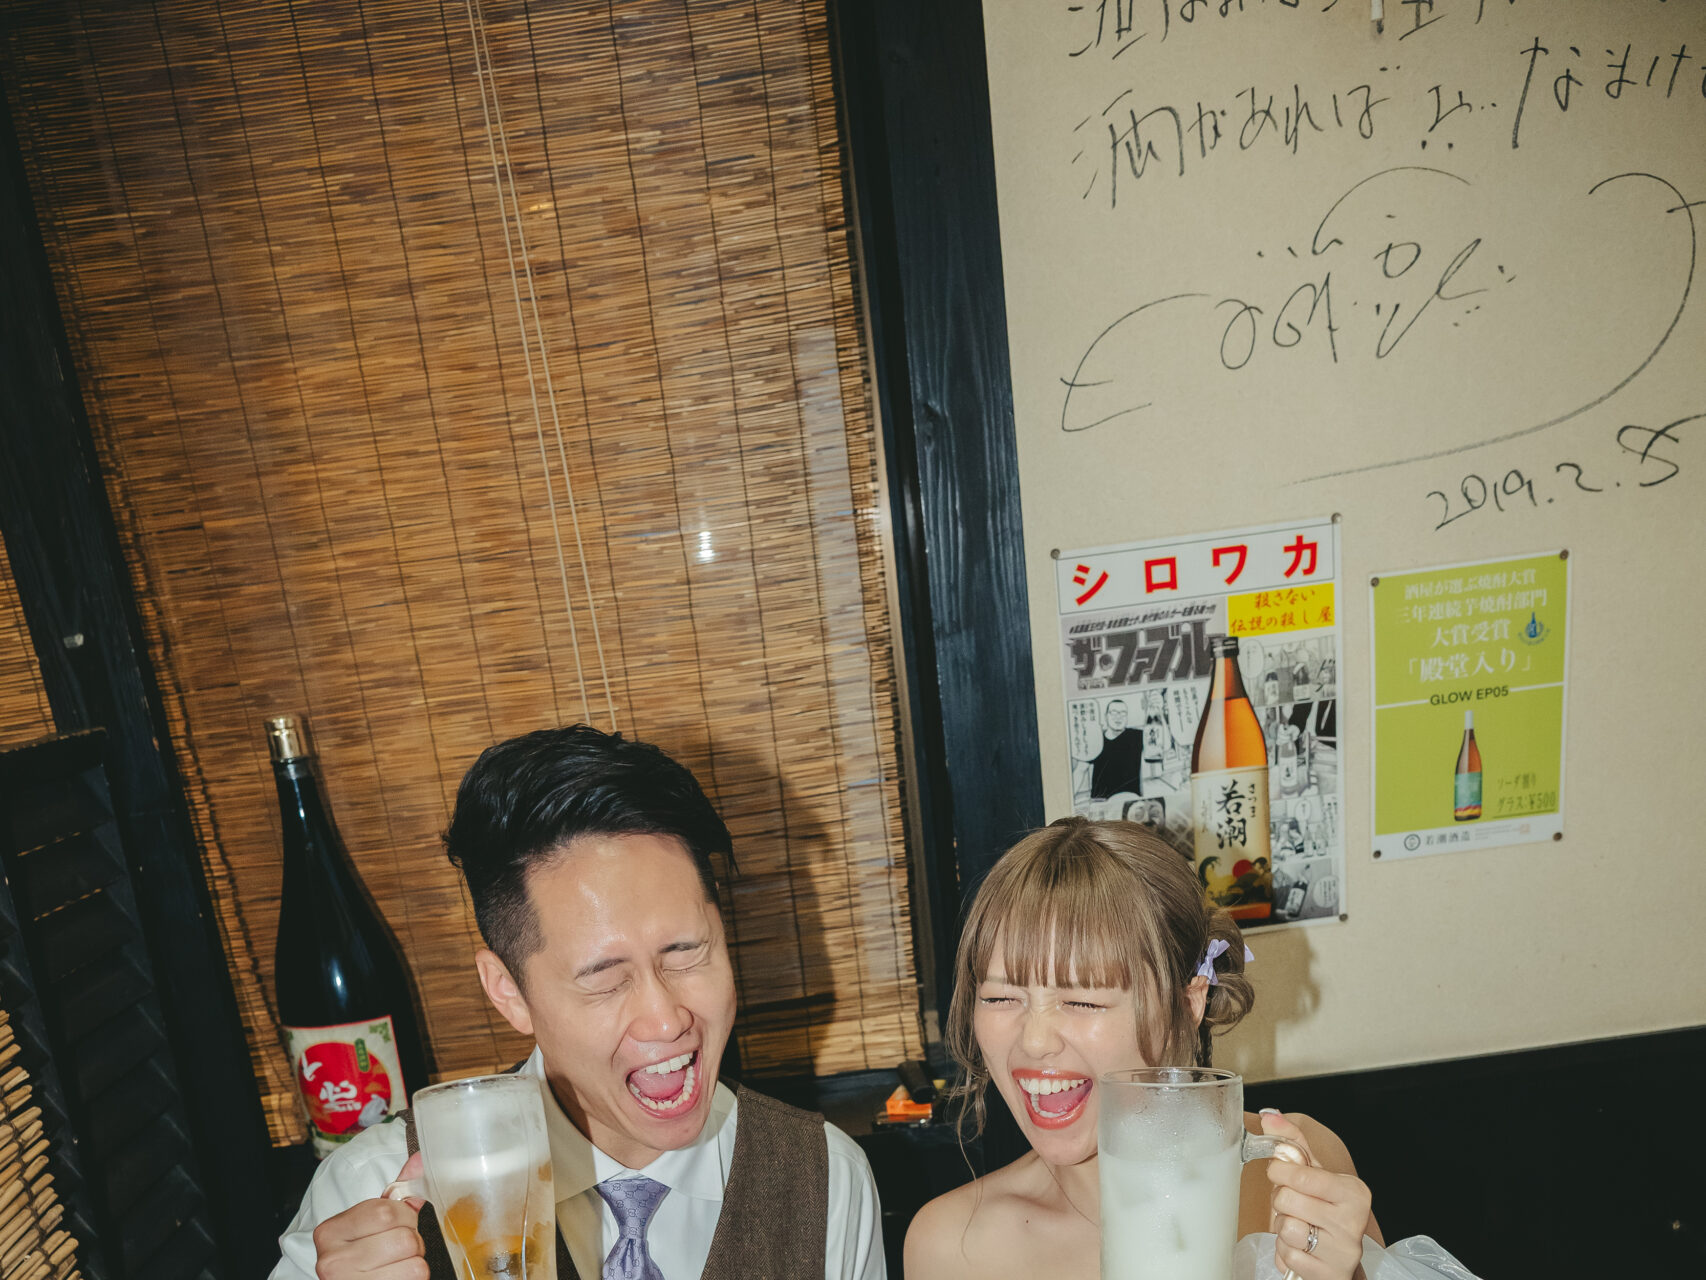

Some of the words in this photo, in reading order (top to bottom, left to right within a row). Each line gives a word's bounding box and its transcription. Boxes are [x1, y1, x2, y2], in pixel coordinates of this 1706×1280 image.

[1073, 534, 1318, 607] シロワカ
[1231, 606, 1332, 634] 伝説の殺し屋
[1431, 618, 1511, 649] 大賞受賞
[1429, 690, 1473, 706] GLOW
[1476, 685, 1509, 700] EP05
[1216, 779, 1247, 850] 若潮
